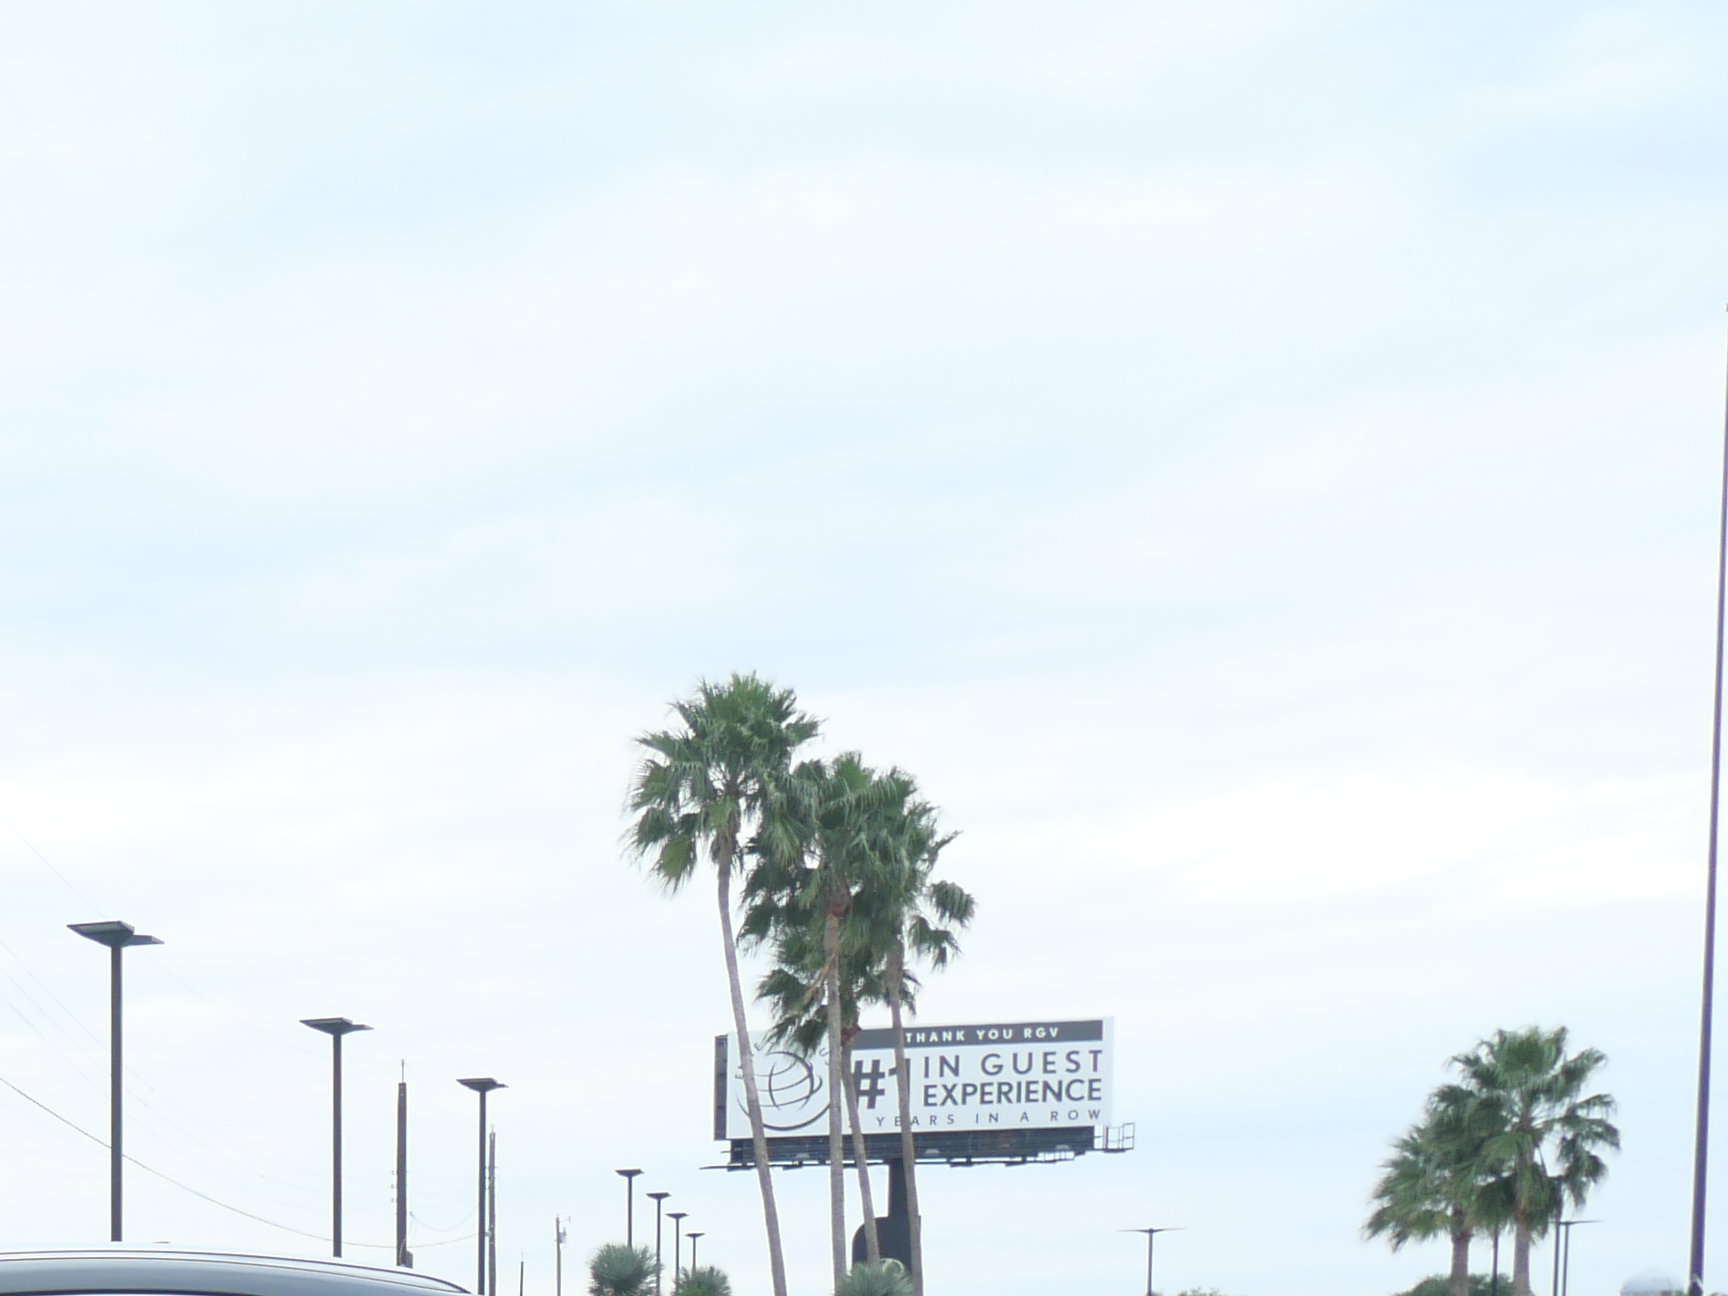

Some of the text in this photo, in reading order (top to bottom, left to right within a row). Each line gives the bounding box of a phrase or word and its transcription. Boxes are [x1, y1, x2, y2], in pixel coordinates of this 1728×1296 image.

[905, 1026, 1060, 1043] THANK YOU RGV
[923, 1049, 1103, 1079] IN GUEST
[922, 1078, 1103, 1108] EXPERIENCE
[876, 1109, 1102, 1128] YEARS IN A ROW
